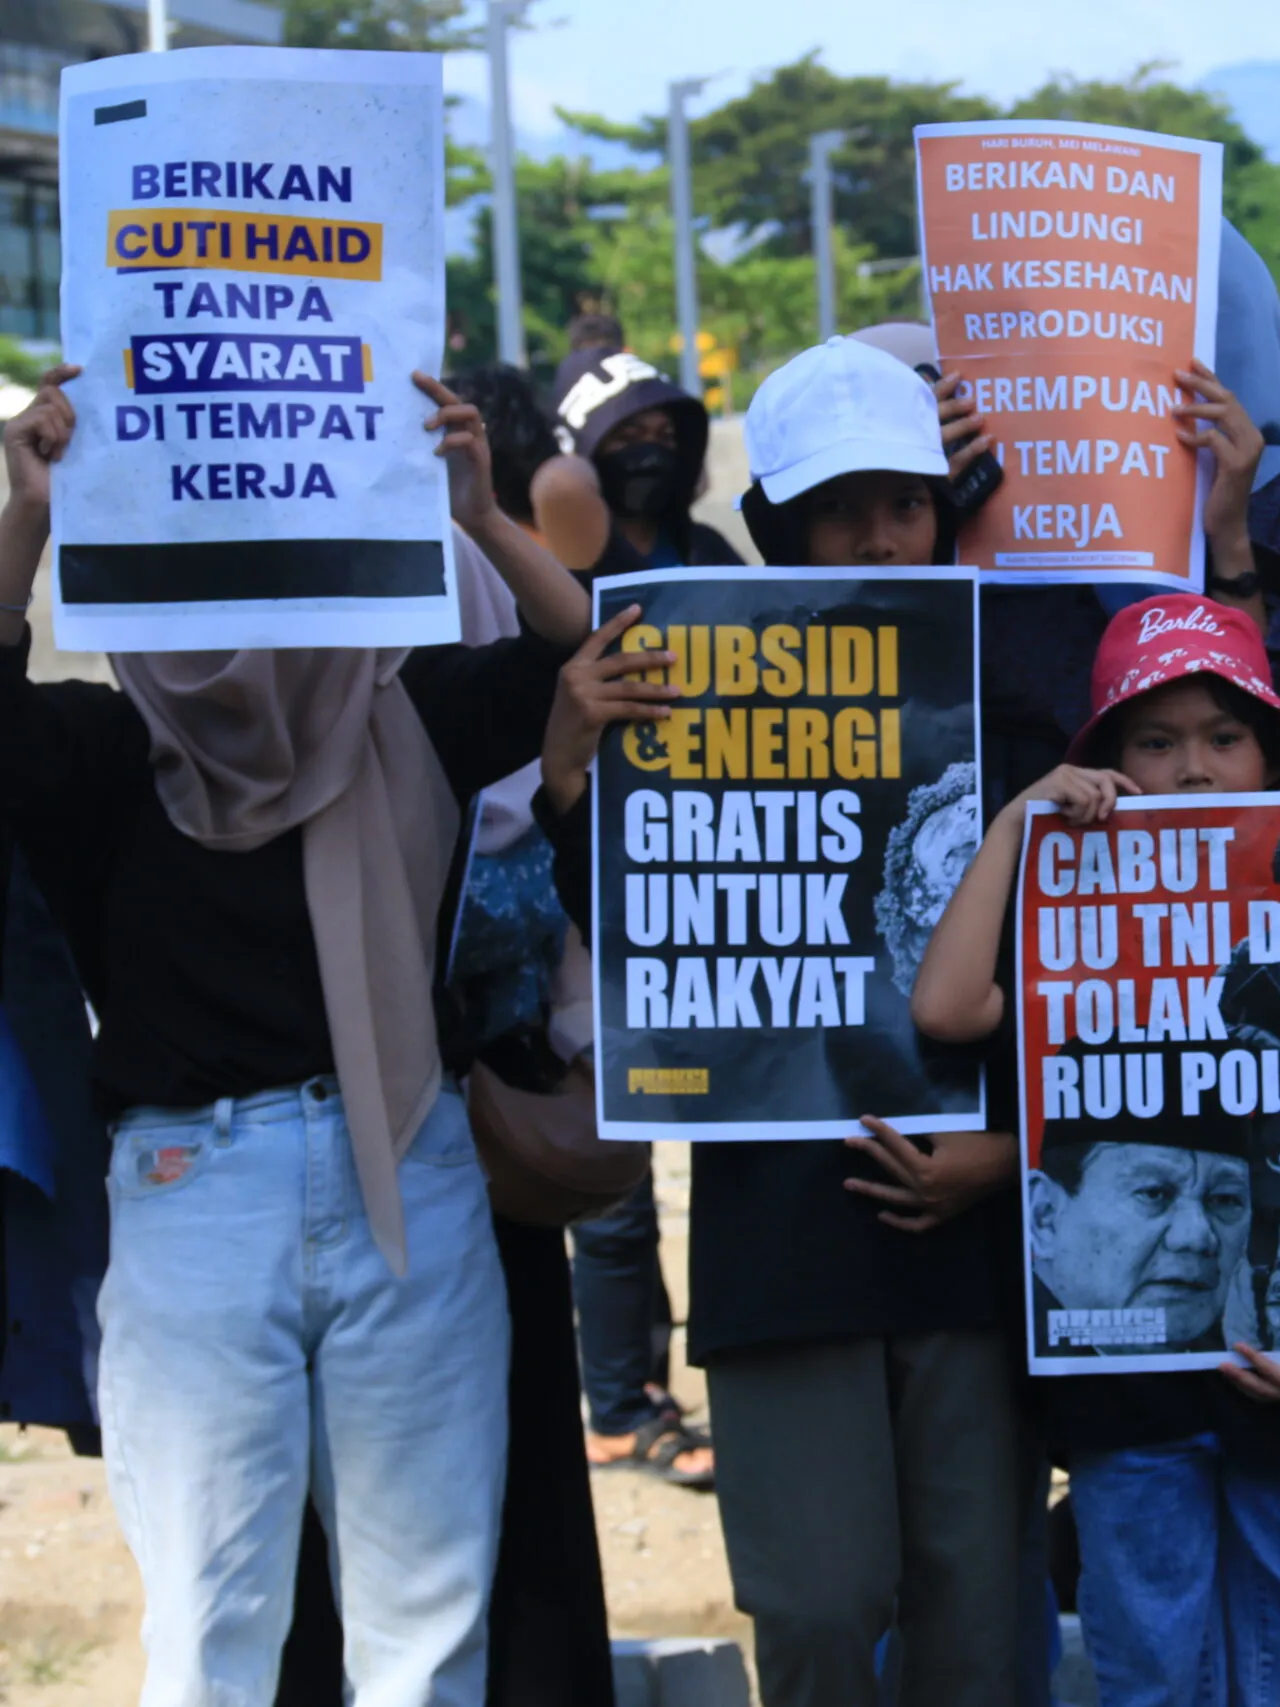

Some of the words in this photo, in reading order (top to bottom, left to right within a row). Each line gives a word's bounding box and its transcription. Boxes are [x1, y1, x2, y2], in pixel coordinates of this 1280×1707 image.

[131, 160, 352, 203] BERIKAN
[945, 160, 1094, 192] BERIKAN
[1106, 166, 1175, 203] DAN
[114, 221, 230, 260] CUTI
[245, 223, 371, 263] HAID
[971, 210, 1142, 245] LINDUNGI
[153, 282, 333, 322] TANPA
[930, 262, 993, 294] HAK
[1003, 260, 1193, 303] KESEHATAN
[964, 310, 1163, 347] REPRODUKSI
[143, 341, 351, 382] SYARAT
[116, 405, 165, 441] DI
[177, 403, 384, 441] TEMPAT
[172, 462, 337, 500] KERJA
[1014, 440, 1170, 479] TEMPAT
[1012, 503, 1123, 549] KERJA
[1137, 605, 1226, 645] Barbie
[621, 624, 899, 698] SUBSIDI
[624, 789, 863, 864] GRATIS
[1037, 826, 1235, 897] CABUT
[625, 873, 850, 946] UNTUK
[1037, 904, 1118, 972] UU
[1133, 901, 1231, 968] TNI
[626, 956, 875, 1030] RAKYAT
[1037, 976, 1228, 1046] TOLAK
[1041, 1052, 1164, 1120] RUU
